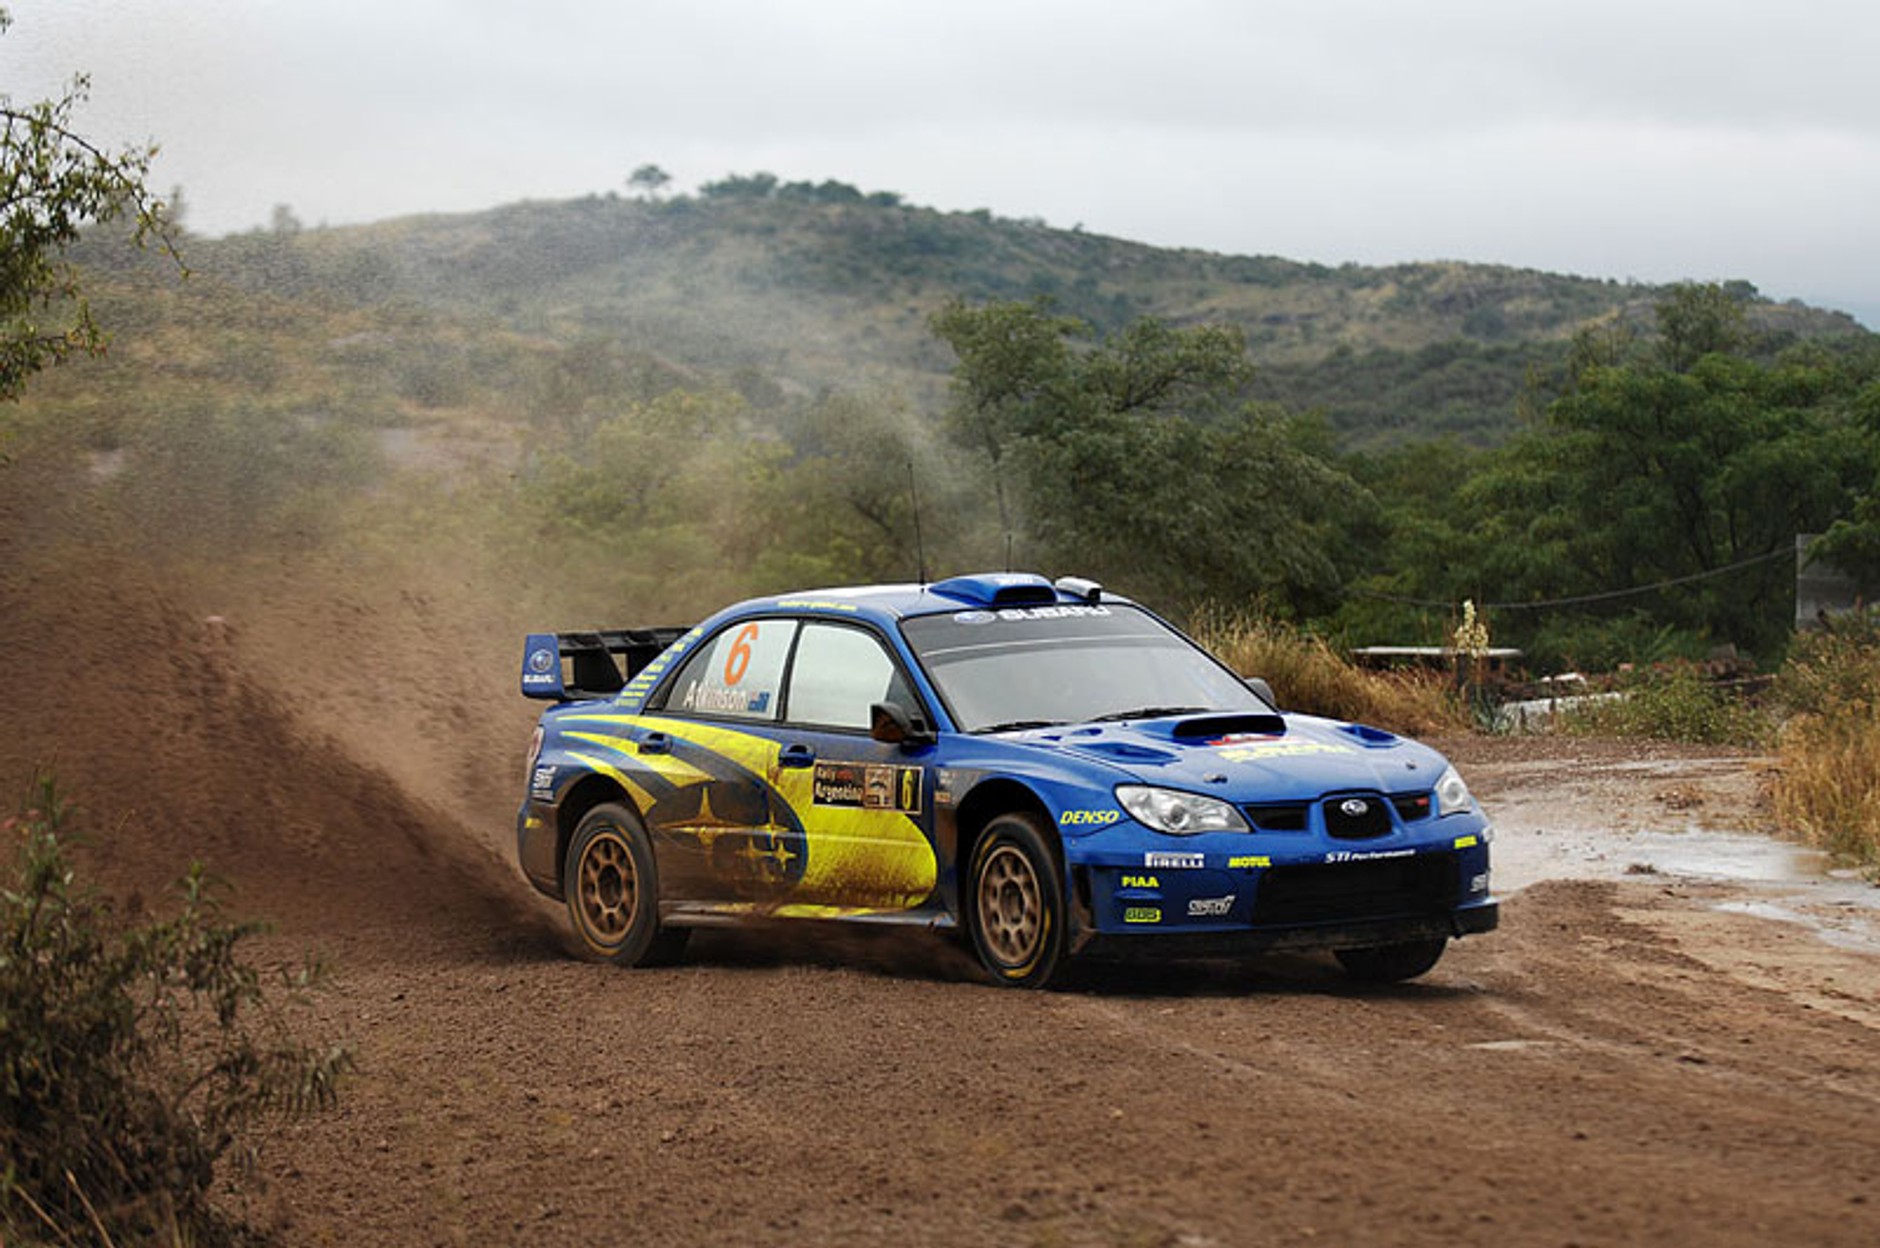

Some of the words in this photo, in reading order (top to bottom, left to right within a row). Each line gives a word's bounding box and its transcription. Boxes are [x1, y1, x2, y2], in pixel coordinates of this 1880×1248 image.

[997, 604, 1111, 620] SUBARU
[723, 622, 759, 687] 6
[902, 769, 913, 811] 6
[1060, 810, 1120, 824] DENSO
[1145, 852, 1205, 868] PIRELLI
[1227, 855, 1272, 868] MOTUL
[1121, 876, 1160, 888] PIAA
